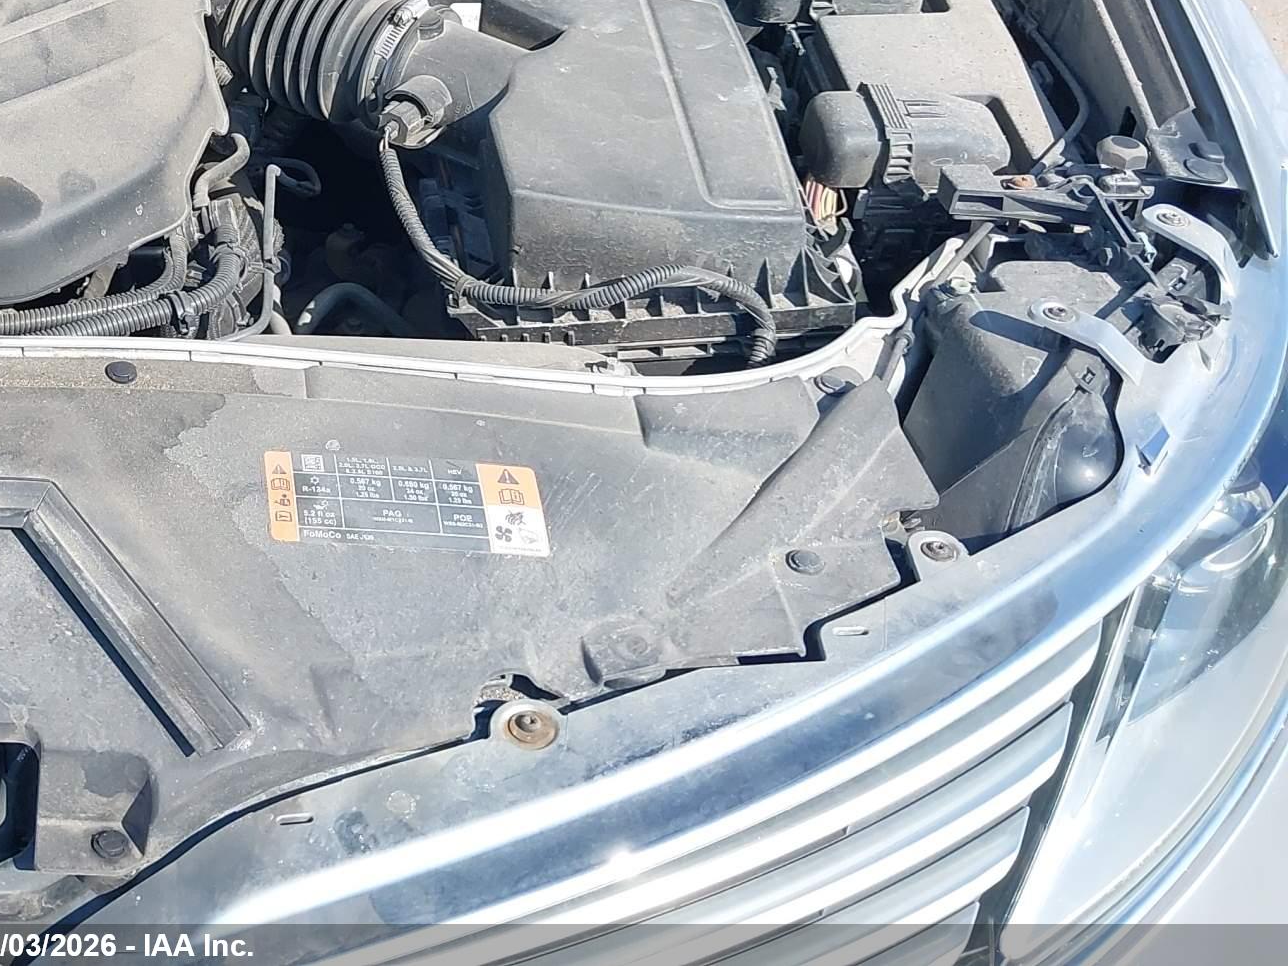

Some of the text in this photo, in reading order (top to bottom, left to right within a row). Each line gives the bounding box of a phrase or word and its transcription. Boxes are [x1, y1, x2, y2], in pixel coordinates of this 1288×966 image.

[371, 478, 382, 488] kg
[419, 481, 430, 490] kg
[463, 484, 474, 493] kg
[304, 517, 337, 526] (155 cc)
[303, 529, 342, 539] FoMoCo
